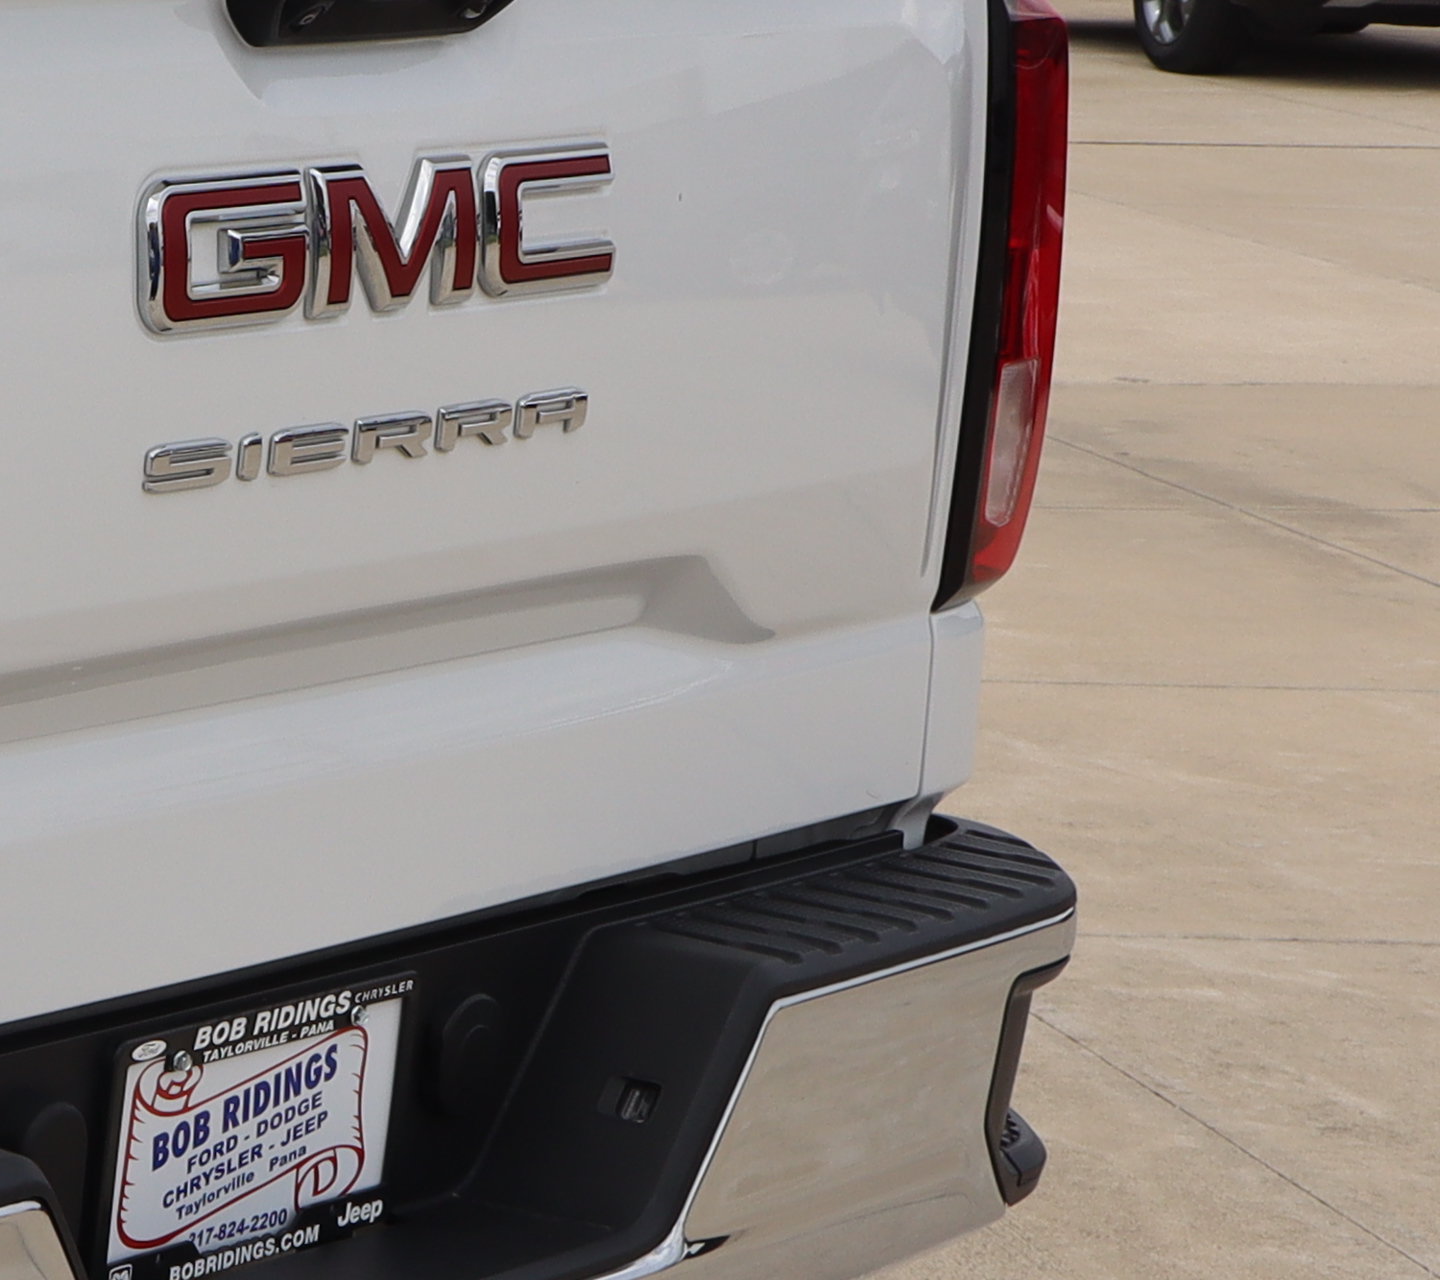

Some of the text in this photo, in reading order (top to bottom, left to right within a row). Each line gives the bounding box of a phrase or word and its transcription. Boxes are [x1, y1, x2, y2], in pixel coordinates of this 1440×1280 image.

[137, 142, 616, 337] GMC
[141, 386, 589, 493] SIERRA
[193, 990, 353, 1051] BOB RIDINGS
[354, 980, 414, 1004] CHRYSLER
[202, 1031, 288, 1064] TAYLORVILLE
[299, 1020, 335, 1039] PANA
[152, 1043, 338, 1172] BOB RIDINGS
[187, 1135, 238, 1174] FORD
[256, 1090, 323, 1138] DODGE
[162, 1143, 263, 1209] CHRYSLER
[280, 1110, 328, 1147] JEEP
[175, 1145, 307, 1220] Taylorville Pana
[336, 1198, 384, 1228] Jeep
